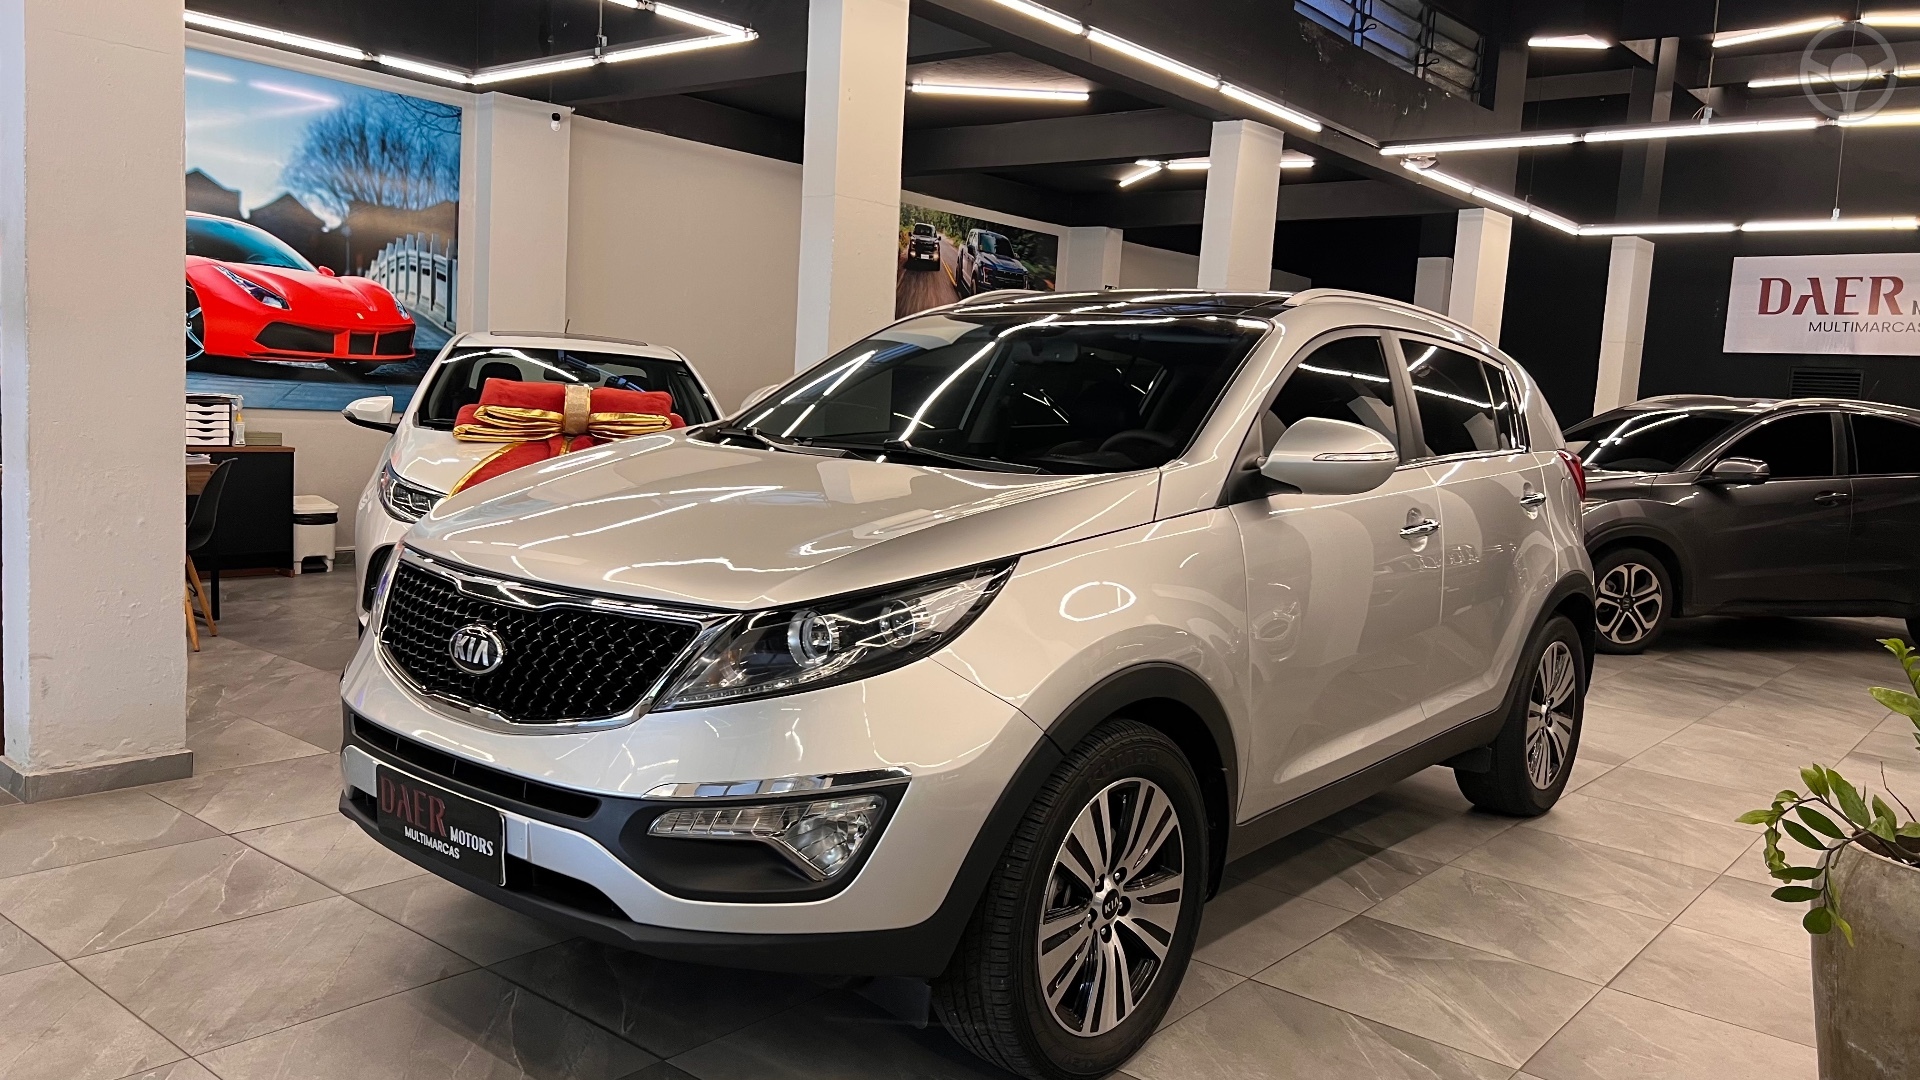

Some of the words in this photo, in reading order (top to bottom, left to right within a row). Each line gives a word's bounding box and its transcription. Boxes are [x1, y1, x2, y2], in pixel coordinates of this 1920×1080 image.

[1757, 276, 1904, 316] DAER
[454, 633, 490, 667] KIA
[380, 776, 447, 837] DAER
[450, 826, 494, 857] MOTORS
[404, 825, 461, 860] MULTIMARCAS
[1104, 896, 1119, 914] KIA
